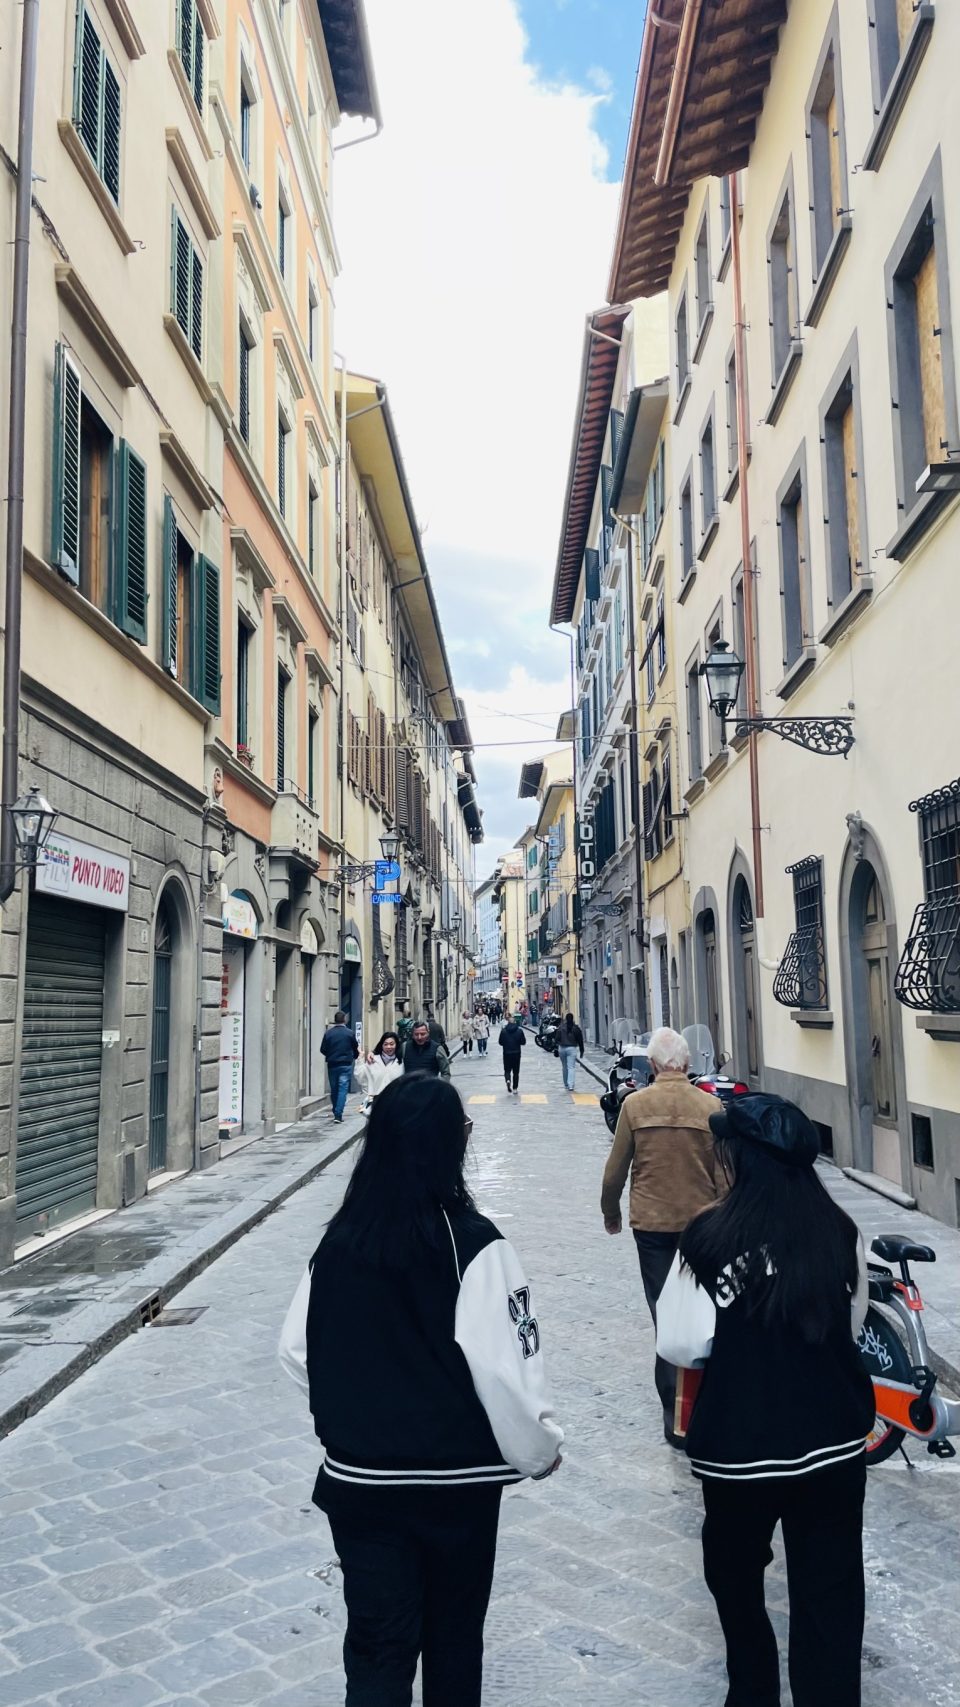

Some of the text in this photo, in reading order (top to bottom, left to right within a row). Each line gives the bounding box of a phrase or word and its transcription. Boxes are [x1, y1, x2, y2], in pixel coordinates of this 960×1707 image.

[549, 825, 561, 883] HOTEL
[579, 806, 595, 877] FOTO
[71, 856, 125, 895] PUNTO VIDEO
[375, 860, 402, 890] P
[231, 1017, 241, 1110] Asian Snacks
